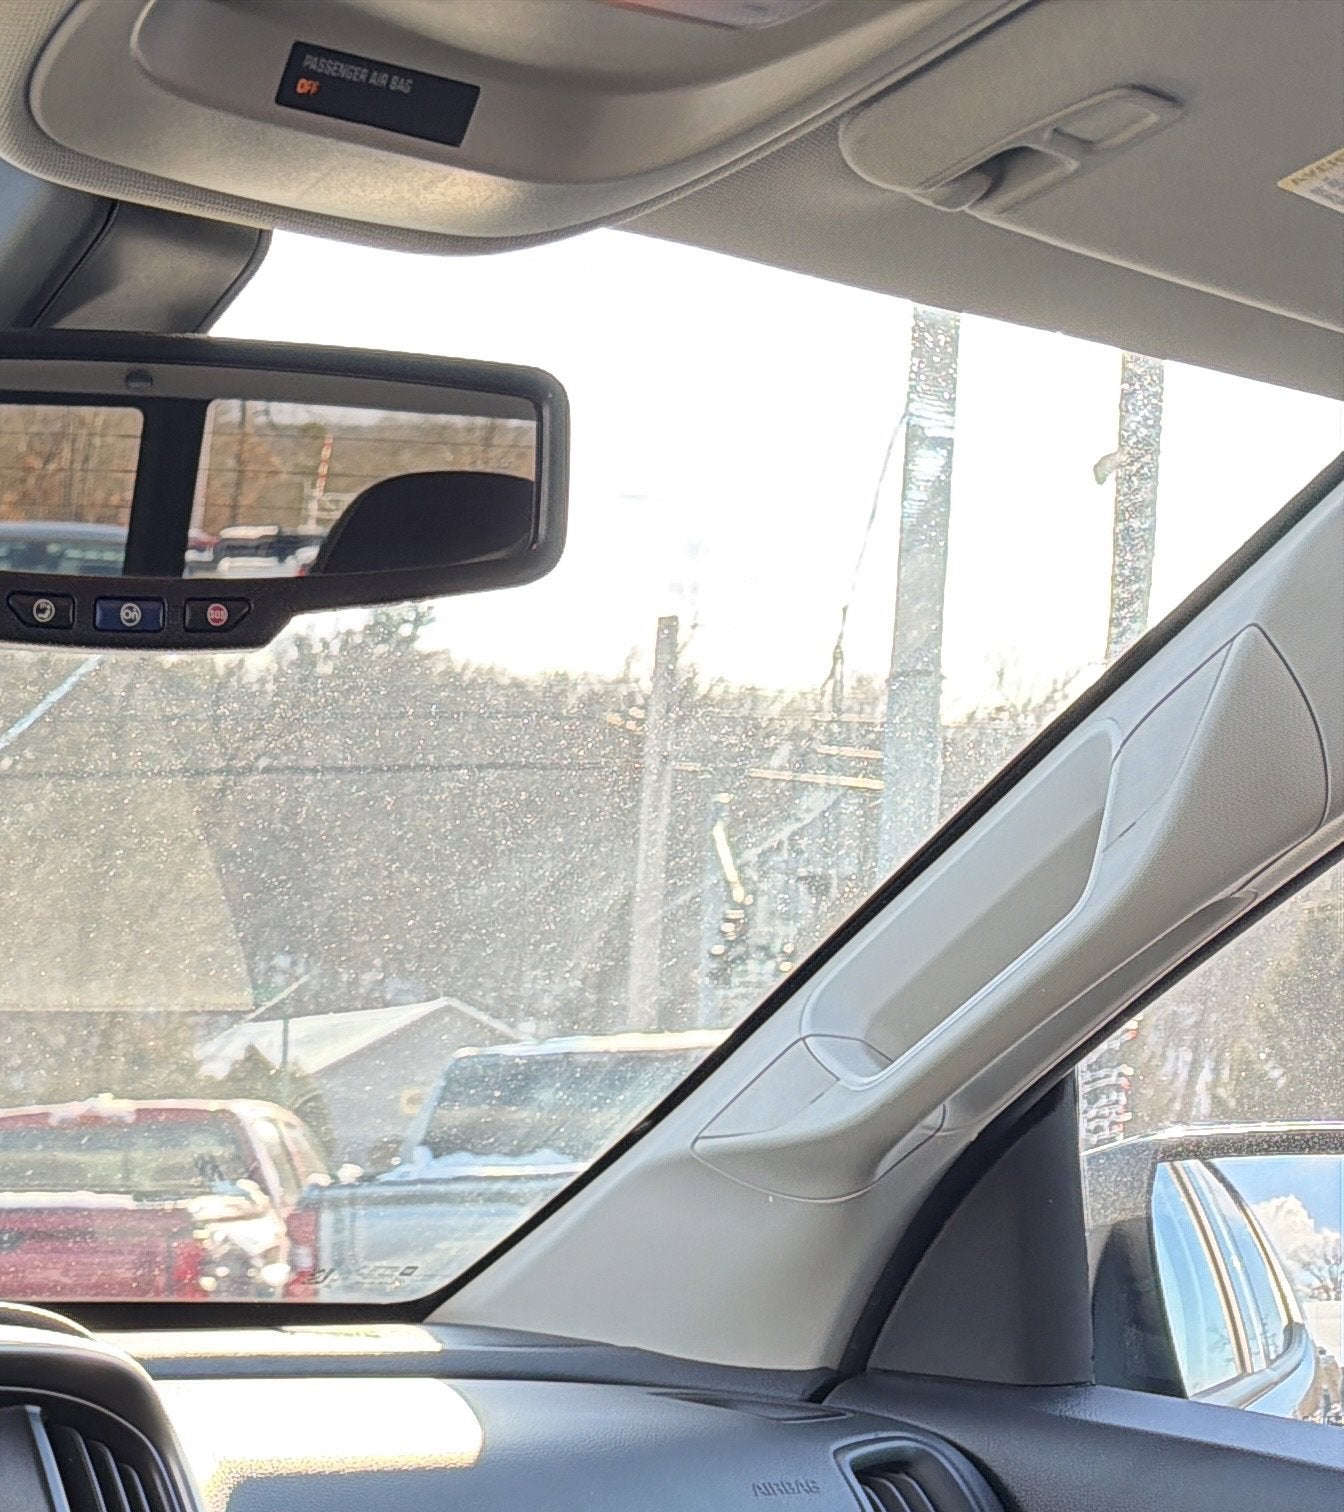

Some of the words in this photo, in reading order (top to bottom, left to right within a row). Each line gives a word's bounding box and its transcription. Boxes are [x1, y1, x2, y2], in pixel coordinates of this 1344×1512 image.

[302, 54, 368, 83] PASSENGER
[368, 70, 387, 88] AIR
[389, 74, 413, 94] BAG
[296, 78, 320, 96] OFF
[752, 1478, 821, 1497] AIRBAG
